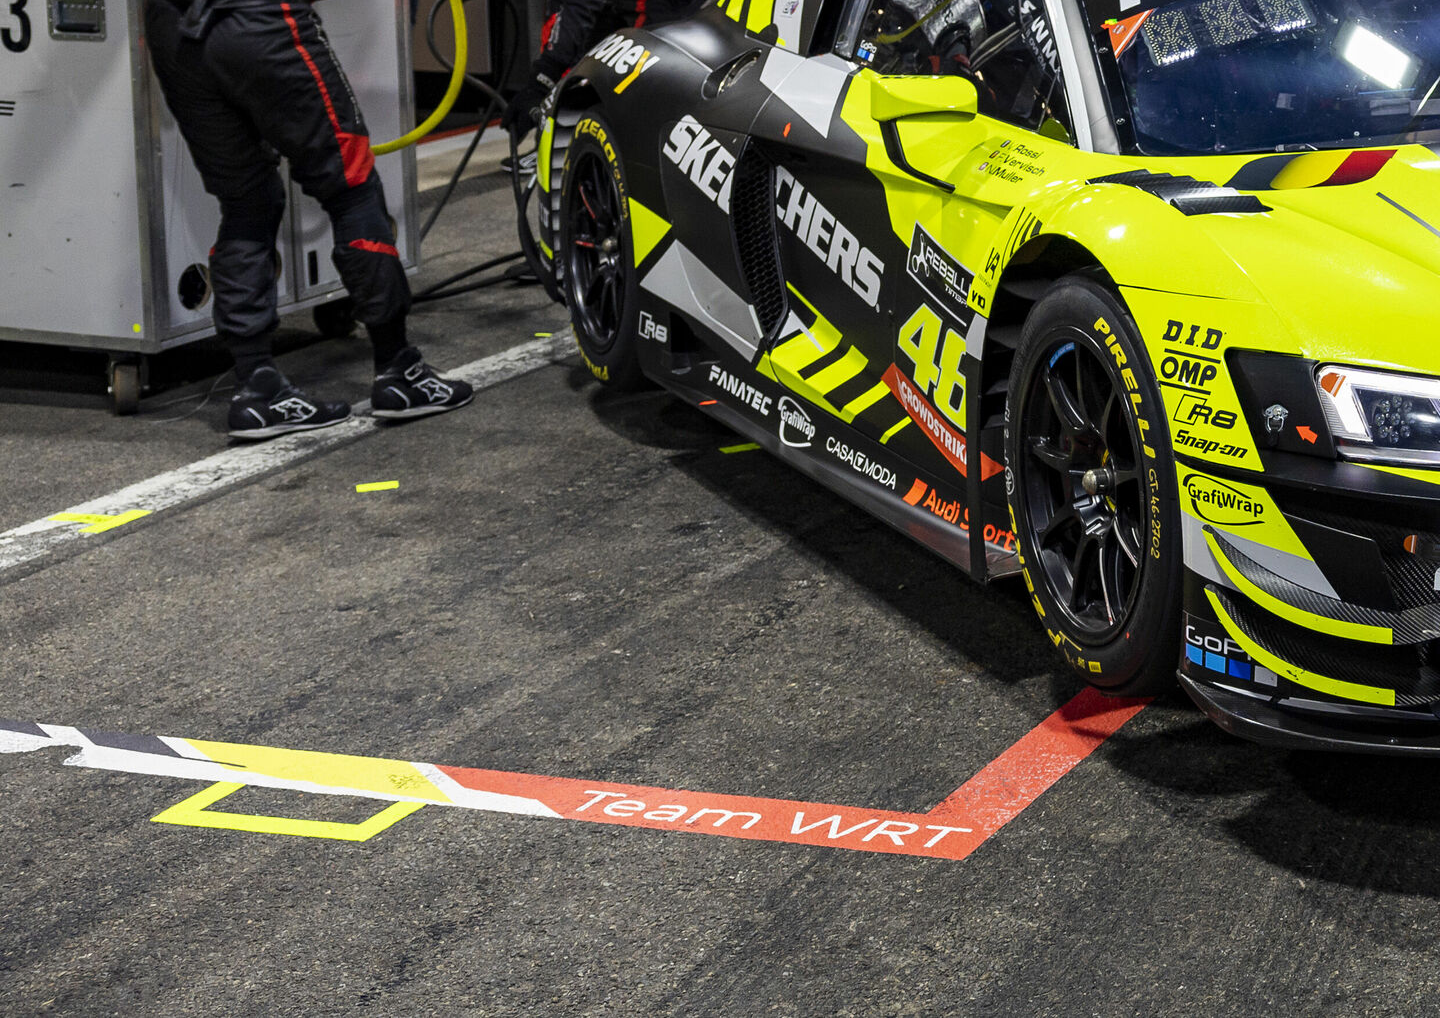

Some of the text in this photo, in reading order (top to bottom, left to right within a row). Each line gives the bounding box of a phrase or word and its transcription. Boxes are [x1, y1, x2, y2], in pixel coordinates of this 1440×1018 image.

[859, 38, 878, 55] GoPro
[641, 315, 669, 343] R8
[897, 302, 968, 434] 46
[1160, 355, 1218, 387] OMP
[707, 364, 774, 416] FANATEC
[1093, 316, 1155, 460] PIRELLI
[779, 402, 817, 443] GrafiWrap
[1180, 399, 1239, 431] R8
[1174, 428, 1250, 460] Snap-on
[924, 480, 961, 526] Audi
[1186, 480, 1265, 518] GrafiWrap
[575, 789, 973, 849] Team WRT
